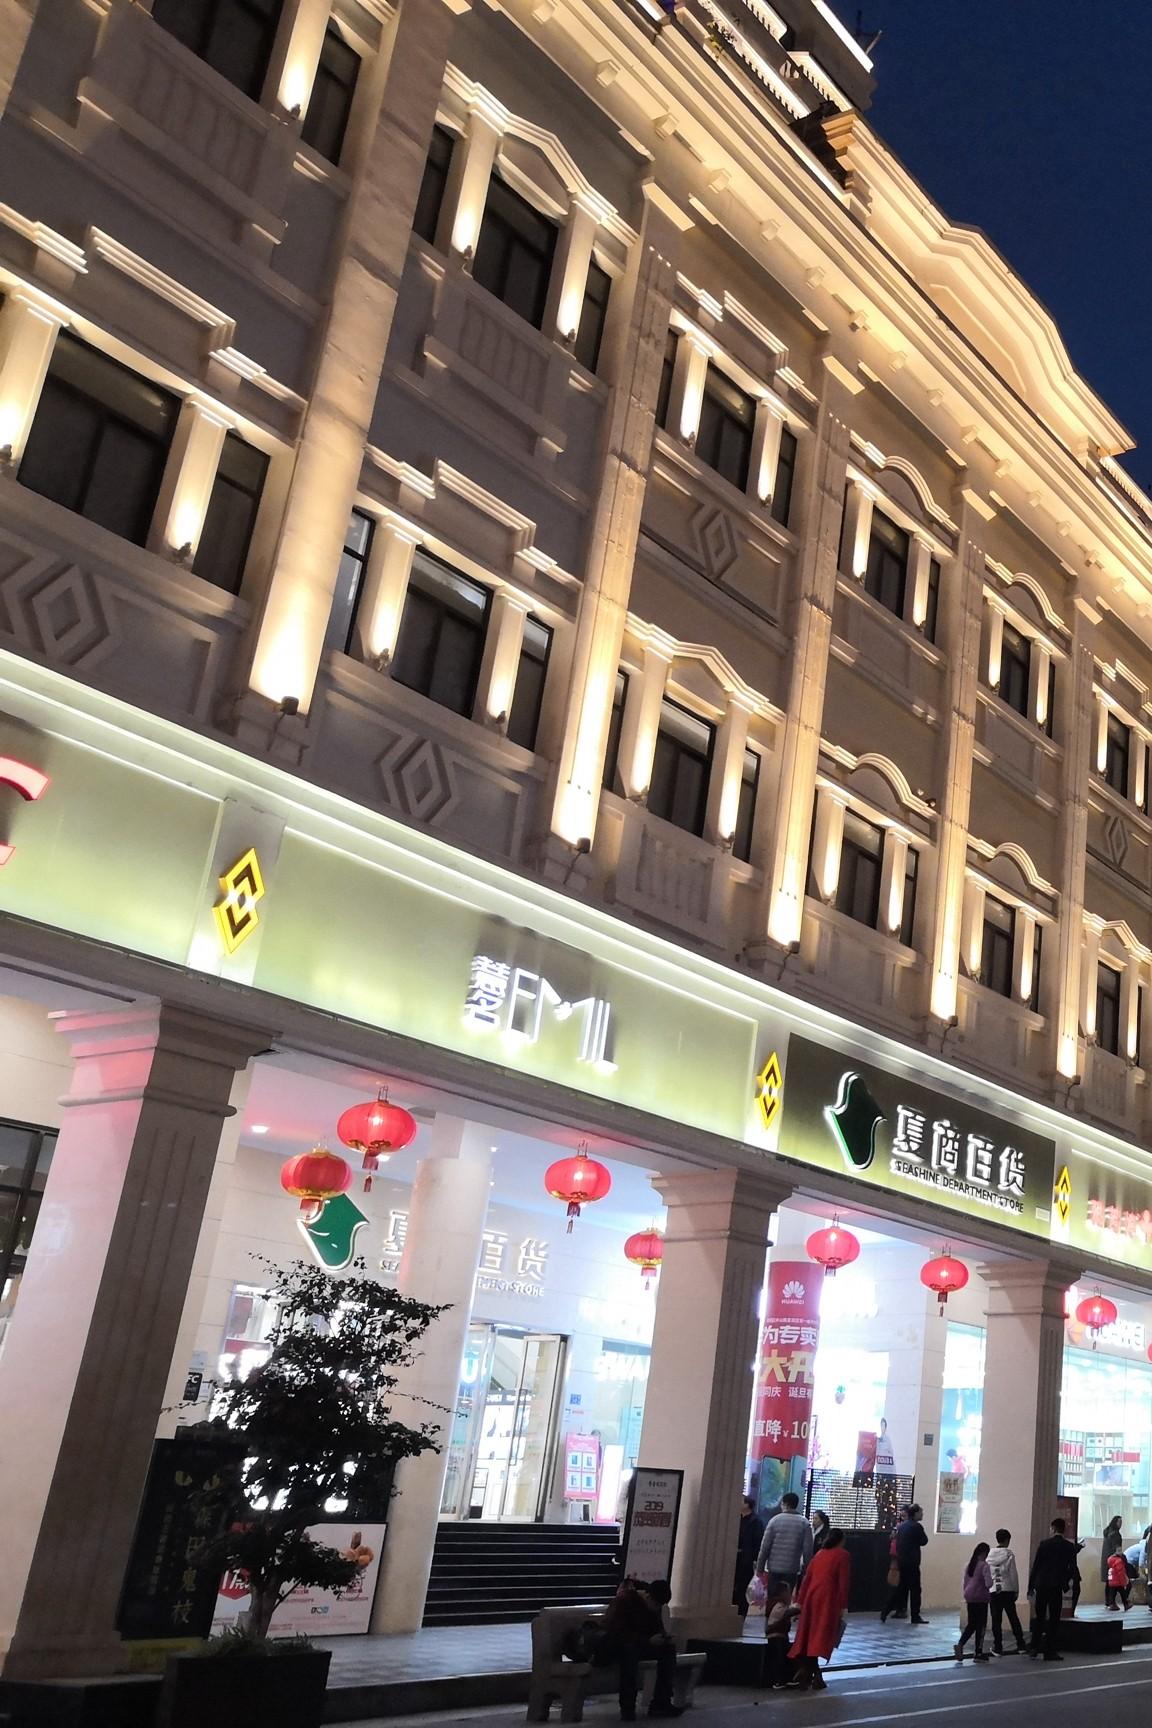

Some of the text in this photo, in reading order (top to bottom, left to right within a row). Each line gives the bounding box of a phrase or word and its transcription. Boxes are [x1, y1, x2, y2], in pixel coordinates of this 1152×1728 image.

[892, 1104, 1027, 1197] 夏商百货
[894, 1159, 1025, 1214] SEASHINE DEPARTMENT STORE
